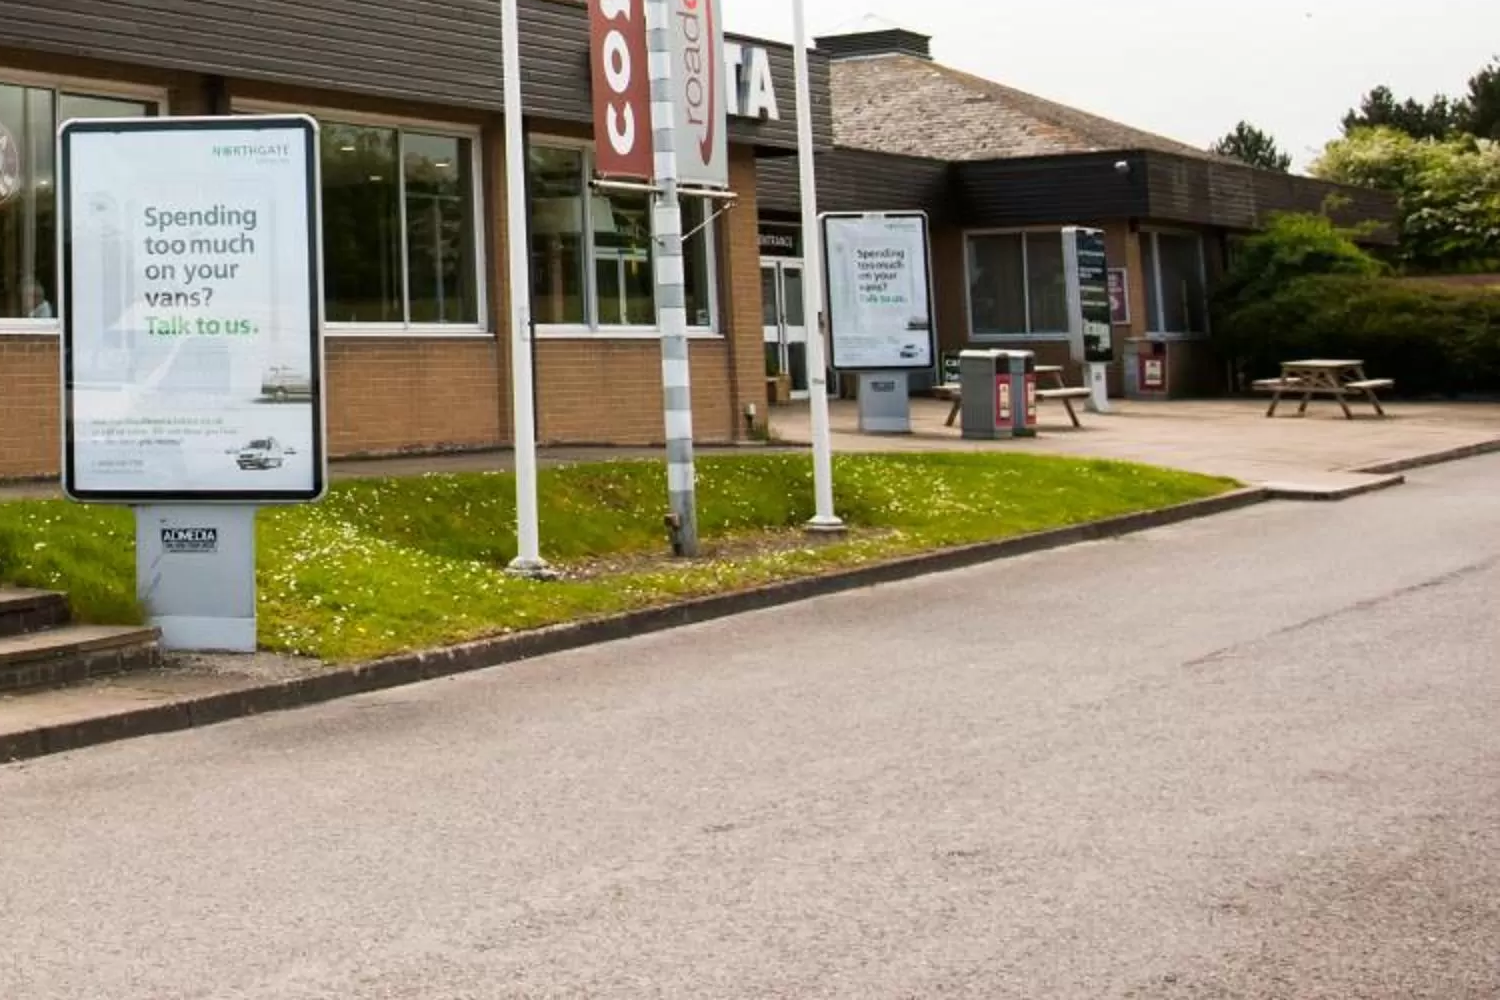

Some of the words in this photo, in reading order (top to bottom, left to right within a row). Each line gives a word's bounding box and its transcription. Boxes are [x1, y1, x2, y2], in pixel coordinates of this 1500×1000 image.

[211, 144, 289, 158] NORTHGATE
[144, 204, 257, 232] Spending
[144, 235, 186, 255] too
[190, 232, 255, 255] much
[144, 264, 176, 281] on
[183, 263, 240, 286] your
[144, 287, 214, 308] vans?
[144, 315, 192, 336] Talk
[196, 317, 221, 336] to
[225, 319, 260, 335] us.
